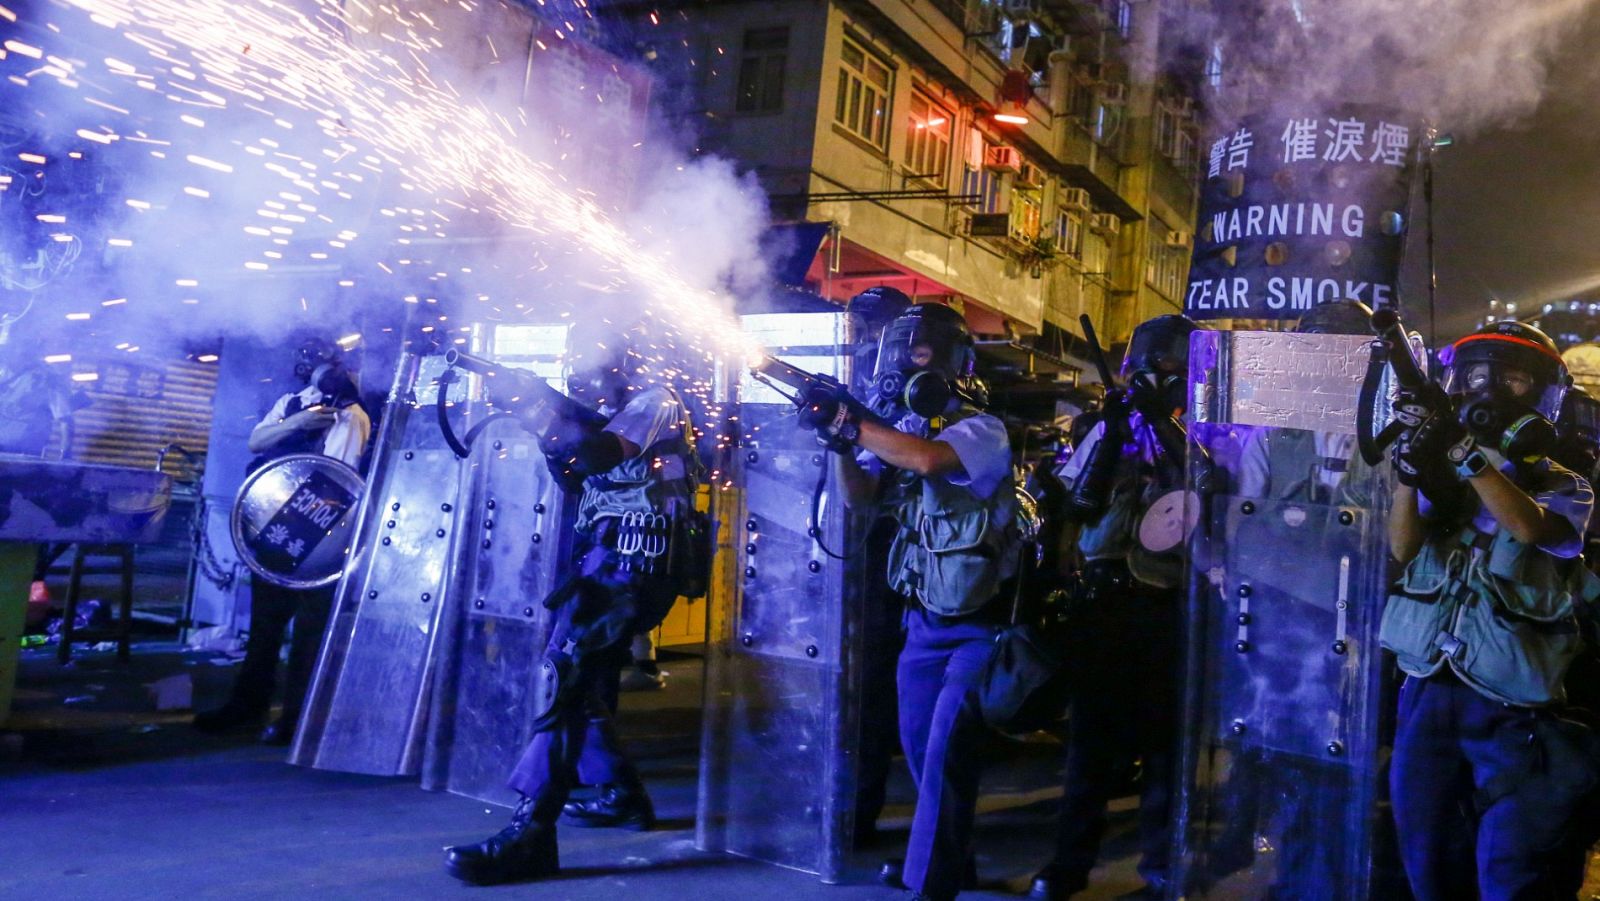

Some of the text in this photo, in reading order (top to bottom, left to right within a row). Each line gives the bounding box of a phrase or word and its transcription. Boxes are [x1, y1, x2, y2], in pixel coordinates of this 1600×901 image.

[1208, 117, 1409, 177] 警告 催淚煙
[1213, 203, 1364, 243] WARNING
[1187, 277, 1249, 310] TEAR
[291, 488, 338, 529] POLICE
